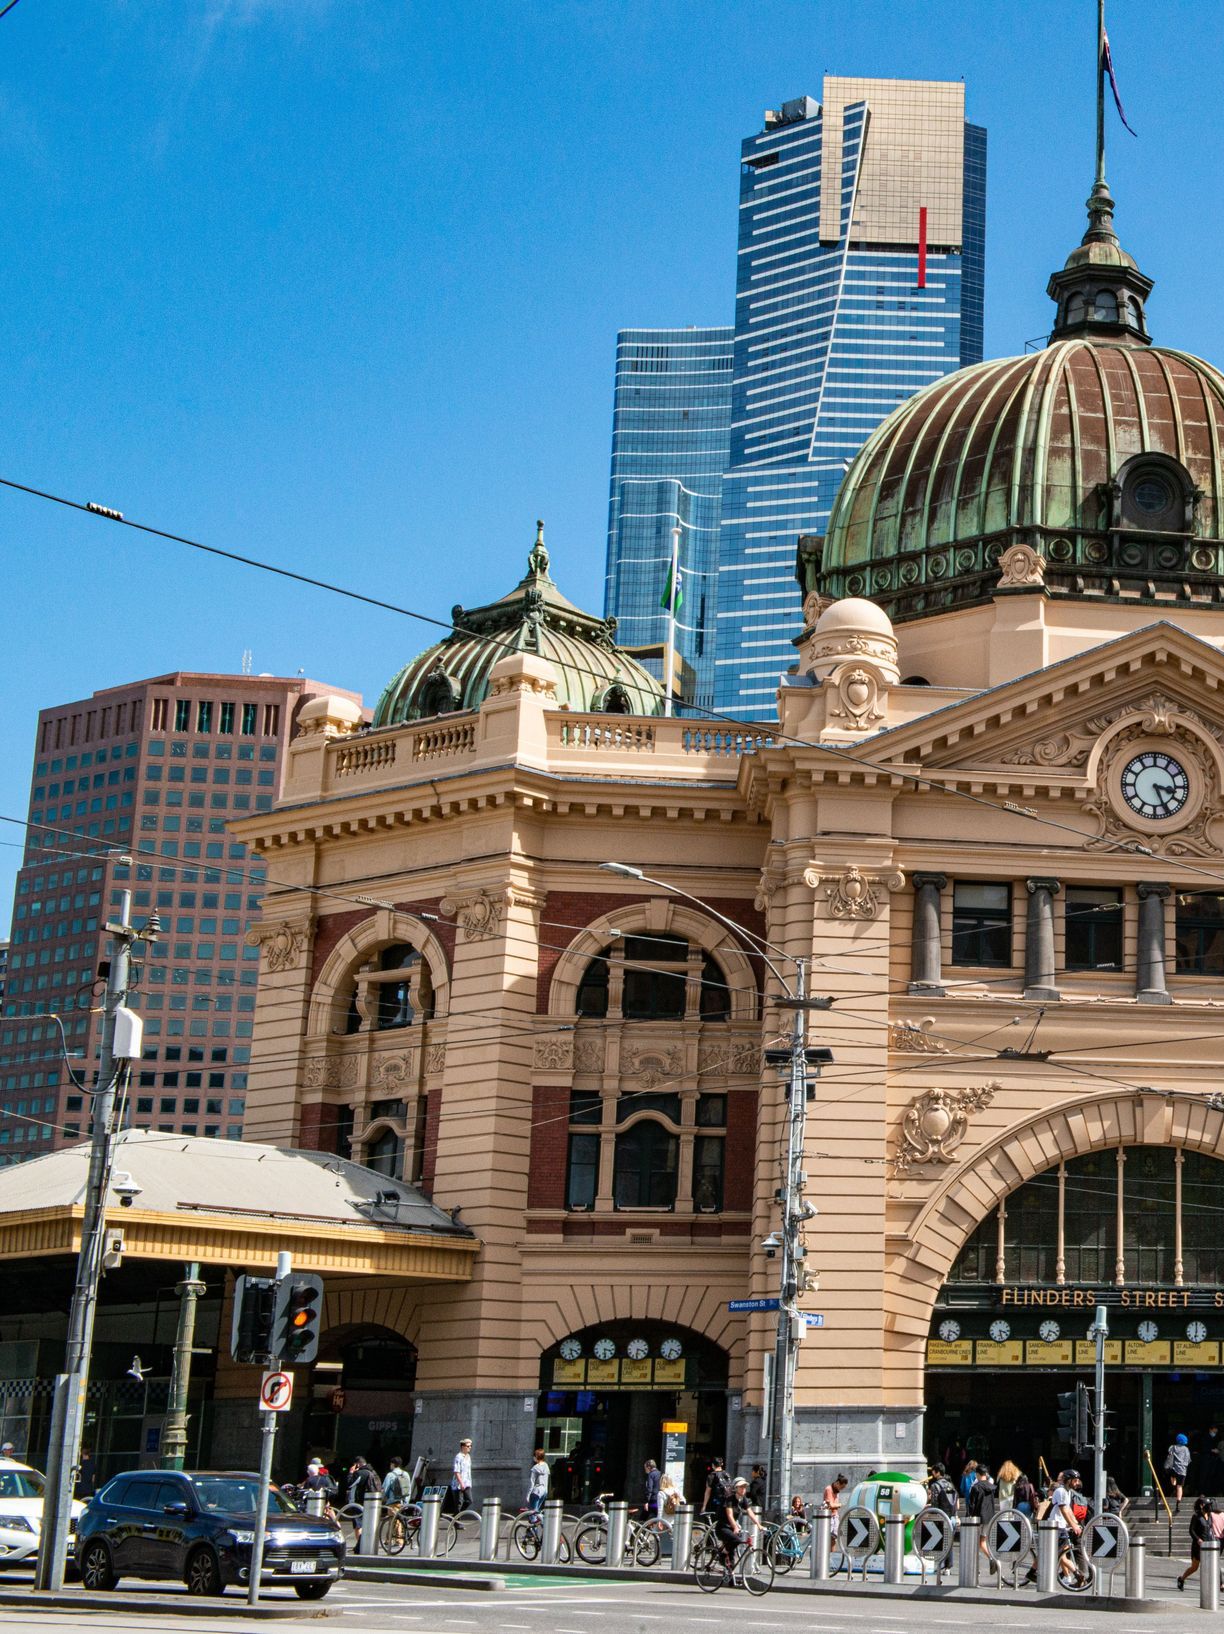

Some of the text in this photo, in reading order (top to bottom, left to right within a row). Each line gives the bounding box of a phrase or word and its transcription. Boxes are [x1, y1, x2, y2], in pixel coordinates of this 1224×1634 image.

[1002, 1289, 1095, 1306] FLINDERS
[1121, 1291, 1191, 1307] STREET
[730, 1301, 760, 1309] Swanston
